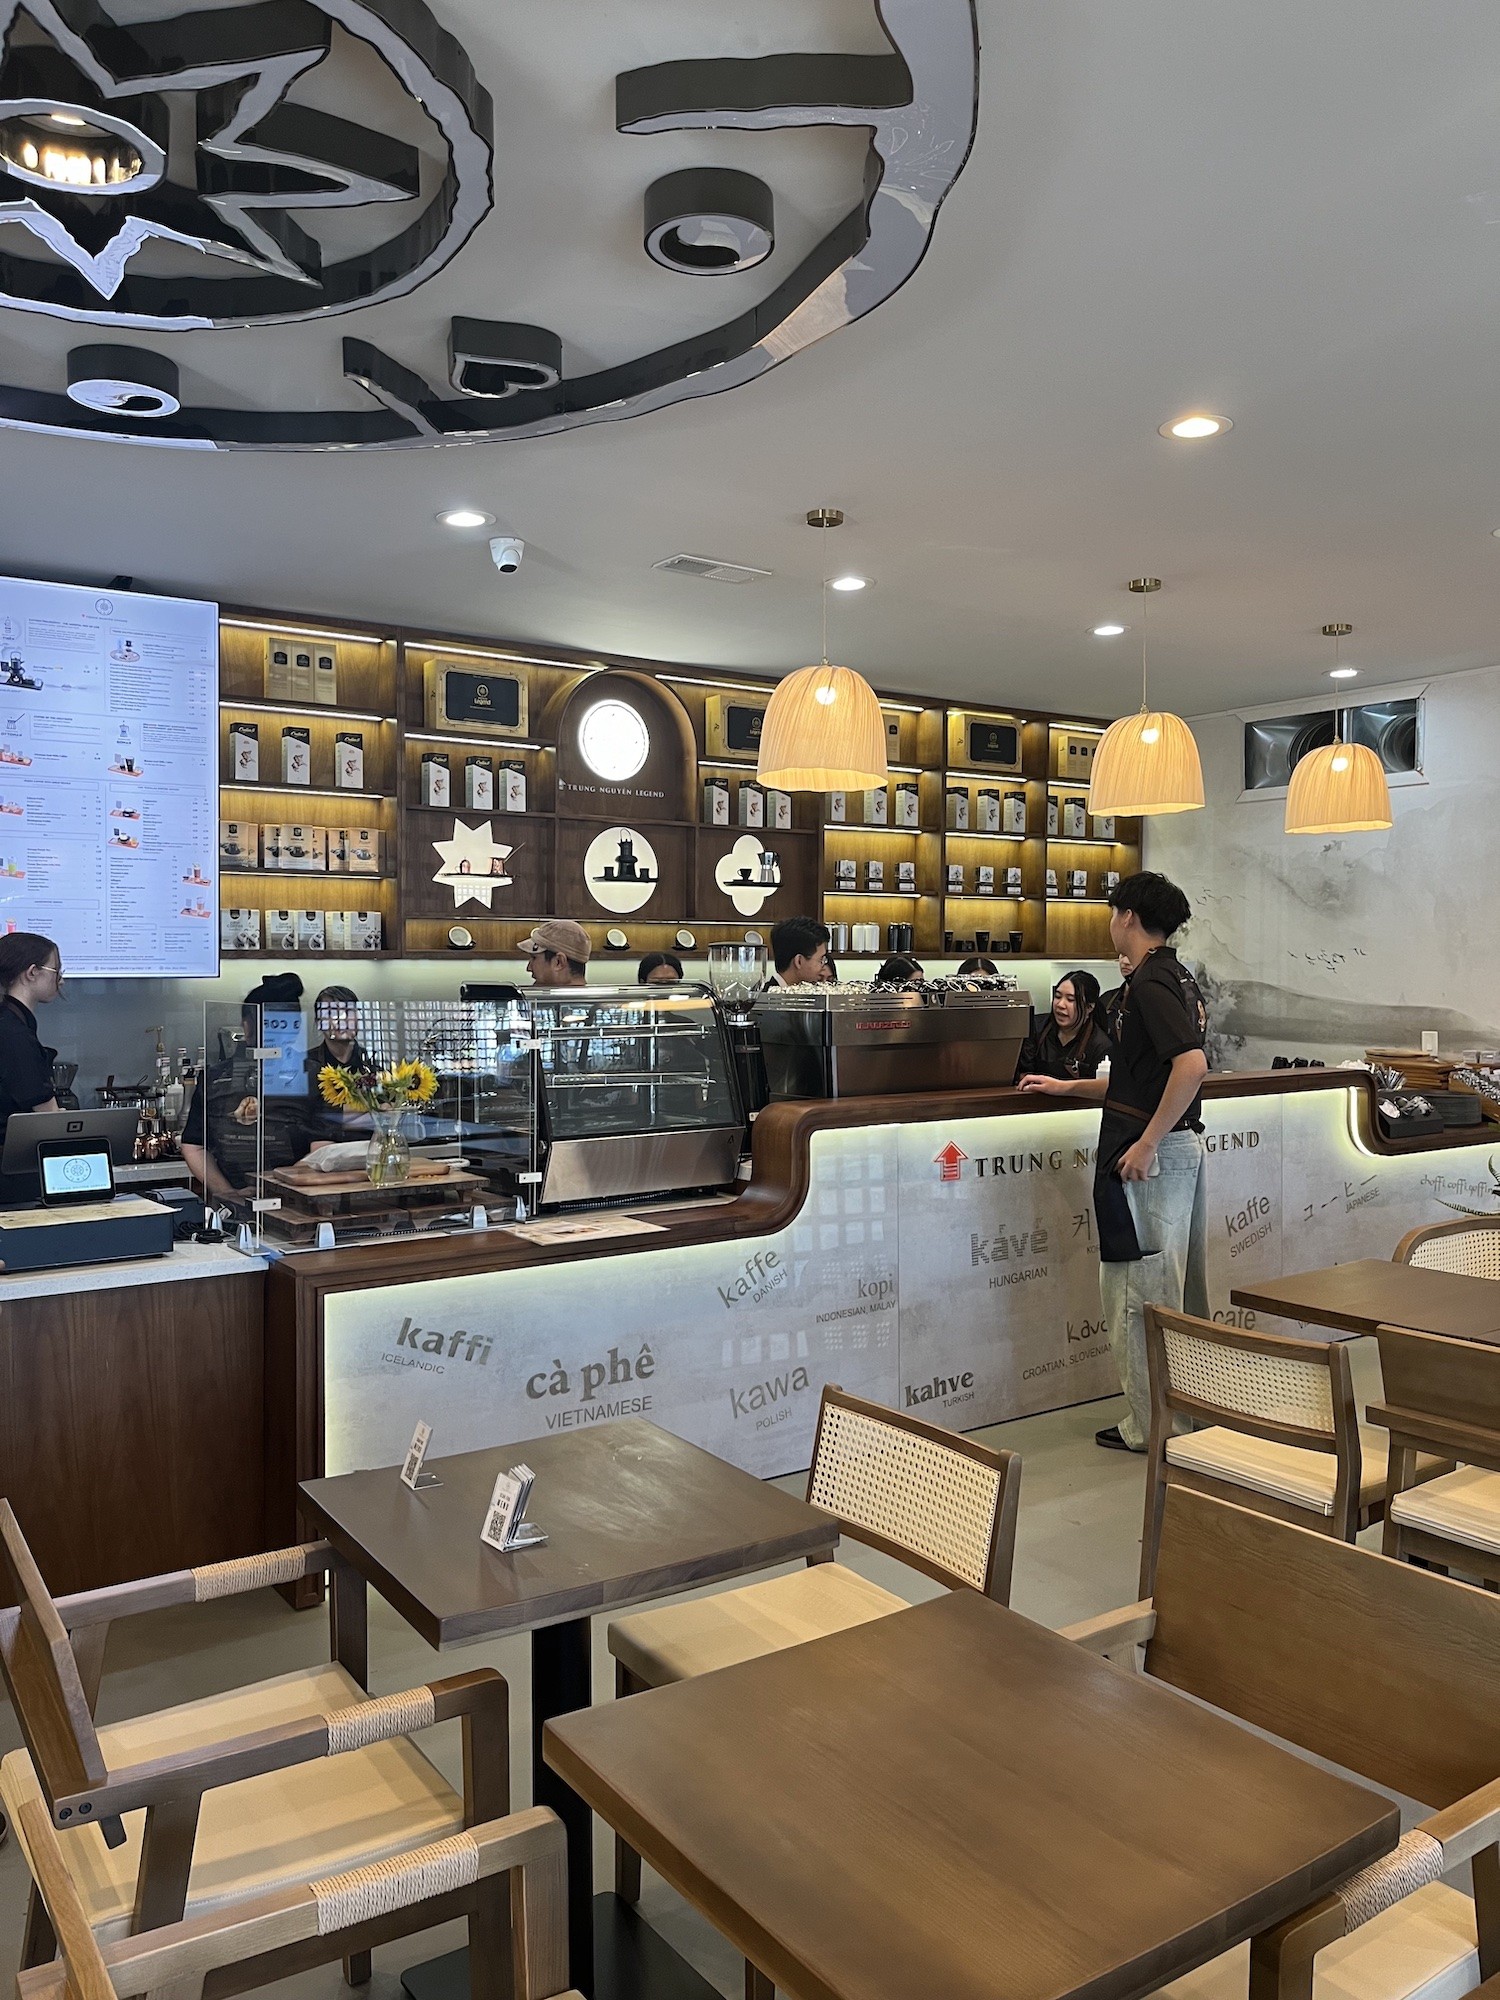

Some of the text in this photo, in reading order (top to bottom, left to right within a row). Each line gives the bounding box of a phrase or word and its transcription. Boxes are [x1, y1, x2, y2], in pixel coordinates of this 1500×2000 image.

[568, 784, 596, 793] TRUNG
[635, 789, 665, 798] LEGEND
[974, 1150, 1062, 1177] TRUNG
[1205, 1130, 1259, 1152] GEND
[1225, 1196, 1270, 1238] kaffe
[1344, 1187, 1380, 1213] JAPANESE
[1071, 1208, 1091, 1241] 커
[1230, 1222, 1272, 1258] SWEDISH
[717, 1250, 781, 1309] kaffe
[752, 1268, 788, 1304] DANISH
[857, 1273, 894, 1300] kopi
[989, 1266, 1048, 1289] HUNGARIAN
[869, 1299, 897, 1316] MALAY
[396, 1317, 494, 1366] kaffi
[381, 1352, 446, 1374] ICELANDIC
[526, 1343, 655, 1402] cà phê
[729, 1366, 810, 1419] kawa
[905, 1371, 975, 1408] kahve
[942, 1391, 975, 1409] TURKISH
[545, 1395, 653, 1430] VIETNAMESE
[756, 1408, 792, 1431] POLISH
